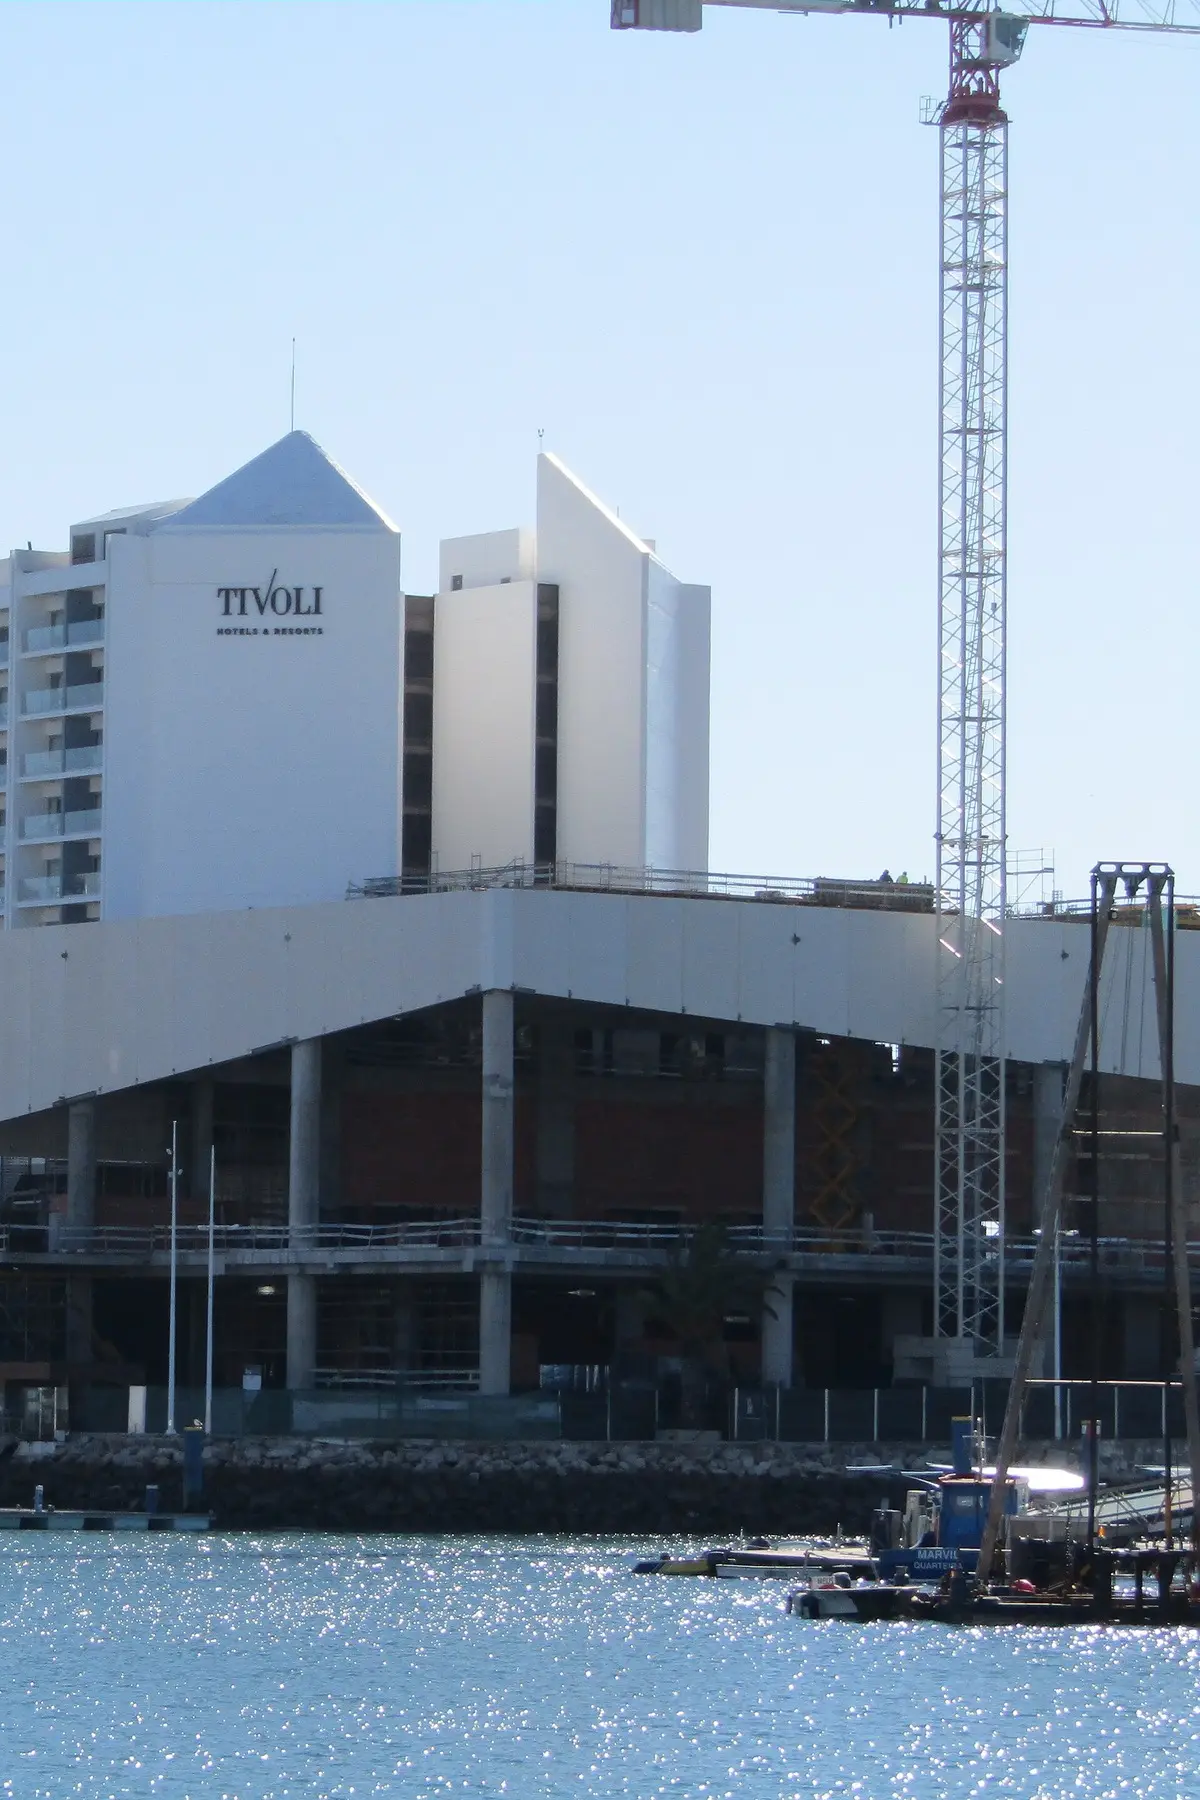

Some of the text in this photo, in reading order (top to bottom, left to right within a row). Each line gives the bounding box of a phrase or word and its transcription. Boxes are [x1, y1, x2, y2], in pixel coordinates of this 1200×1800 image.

[217, 568, 324, 616] TIVOLI
[216, 627, 323, 636] HOTELS & RESORTS
[917, 1549, 958, 1560] MARVIL
